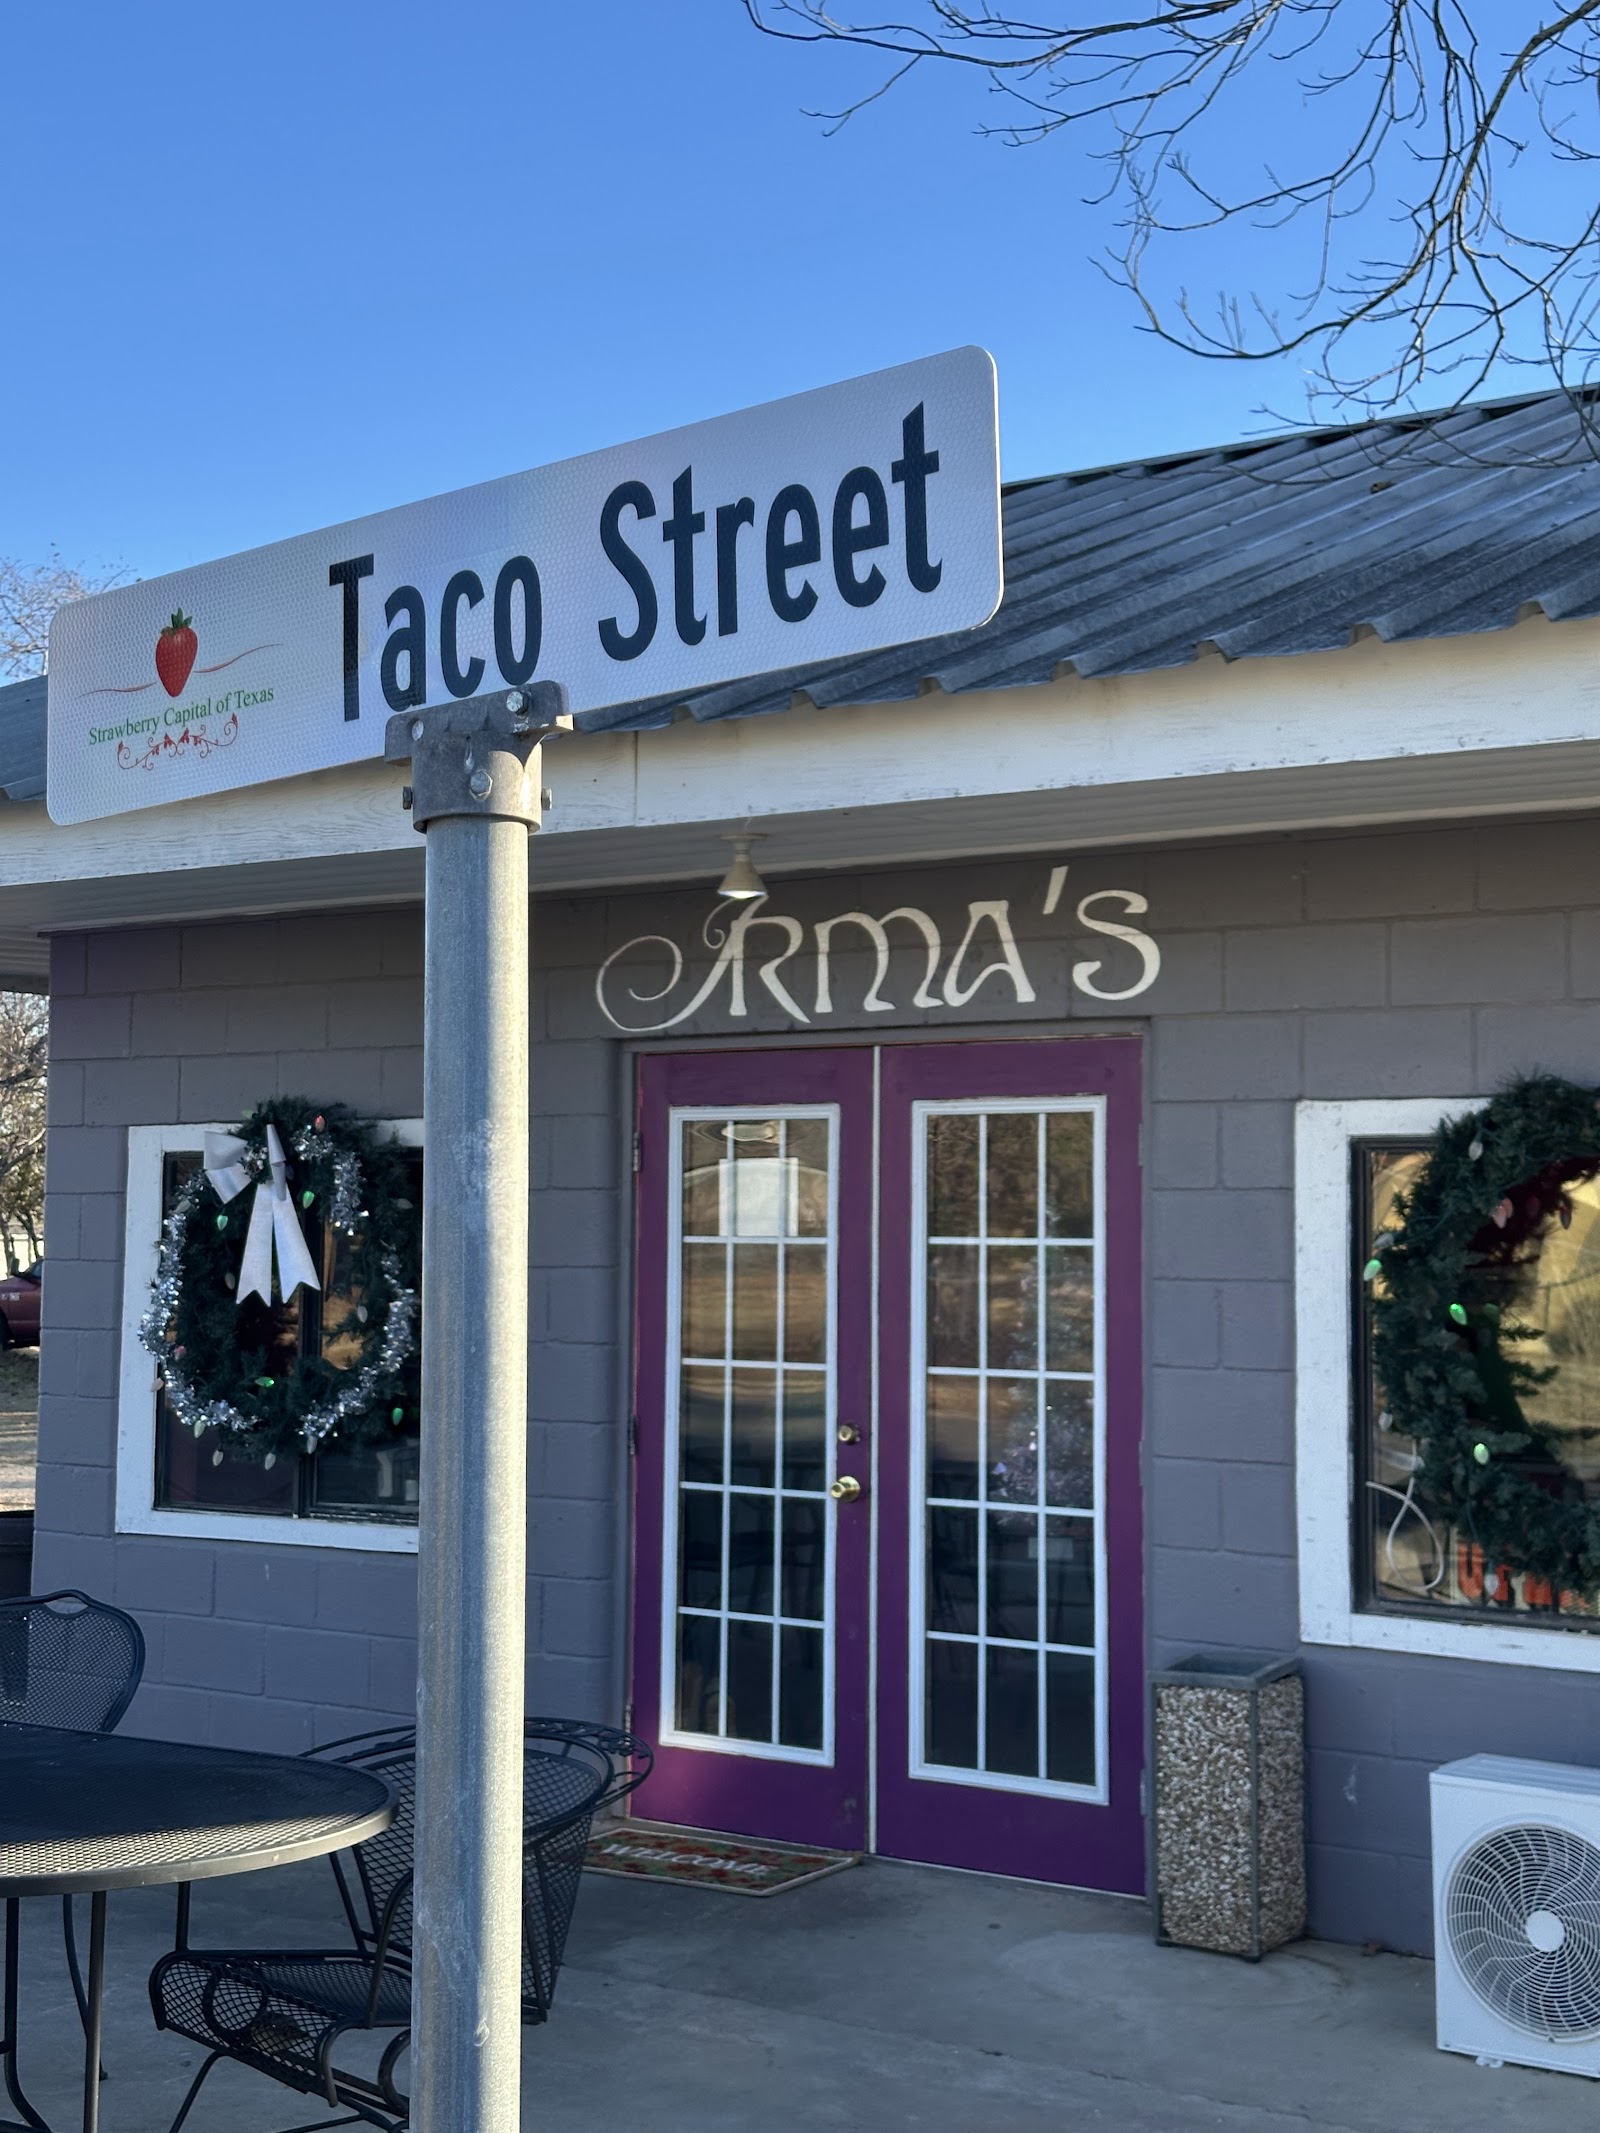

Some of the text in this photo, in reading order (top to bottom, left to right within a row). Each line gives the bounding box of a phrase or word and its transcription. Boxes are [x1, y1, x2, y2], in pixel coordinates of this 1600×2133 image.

[329, 401, 943, 722] Taco Street
[89, 688, 275, 745] Strawberry Capital of Texas
[601, 1843, 778, 1876] WELCOME
